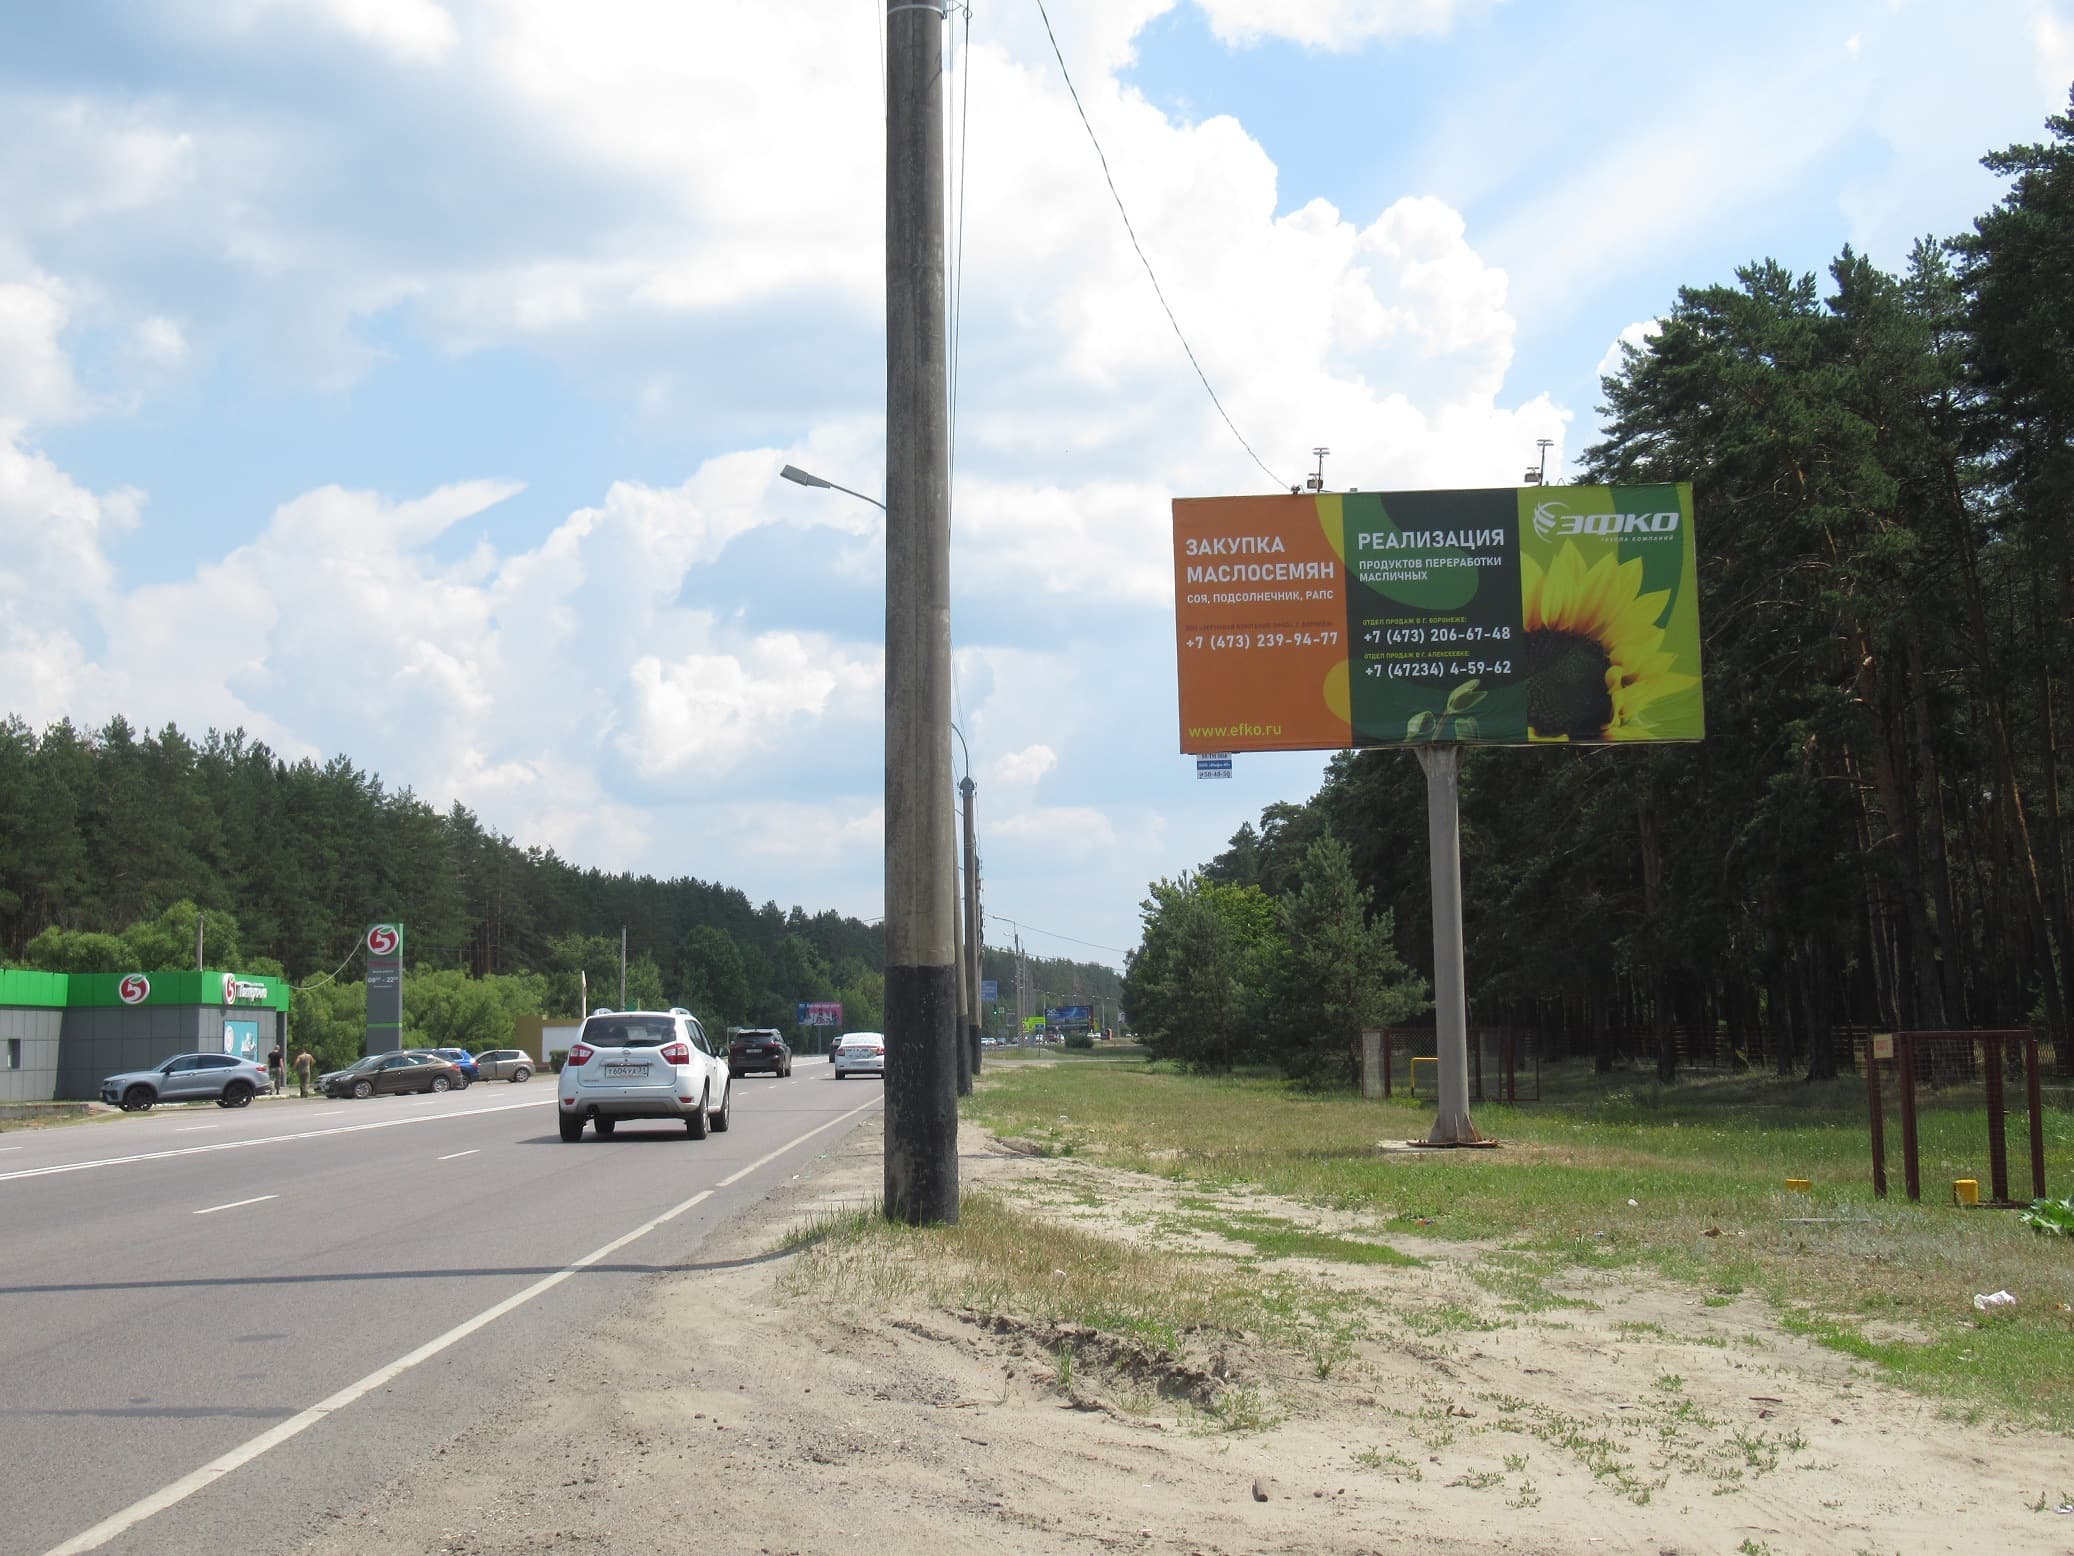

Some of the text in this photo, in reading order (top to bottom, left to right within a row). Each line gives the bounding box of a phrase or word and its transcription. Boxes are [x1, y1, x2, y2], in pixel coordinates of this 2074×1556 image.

[1185, 536, 1285, 556] ЗАКУПКА
[1358, 529, 1505, 550] РЕАЛИЗАЦИЯ
[1187, 562, 1335, 583] МАСЛОСЕМЯН
[1359, 556, 1502, 571] ПРОДУКТОВ ПЕРЕРАБОТКИ
[1359, 571, 1428, 582] МАСЛИЧНЫХ
[1187, 590, 1334, 605] СОЯ, ПОДСОЛНЕЧНИК, РАПС
[1186, 632, 1338, 650] +7 (473) 239-94-77
[1363, 626, 1511, 645] +7 (473) 206-67-48
[1365, 660, 1512, 679] +7 (47234) 4-59-62
[1188, 723, 1282, 738] www.efko.ru
